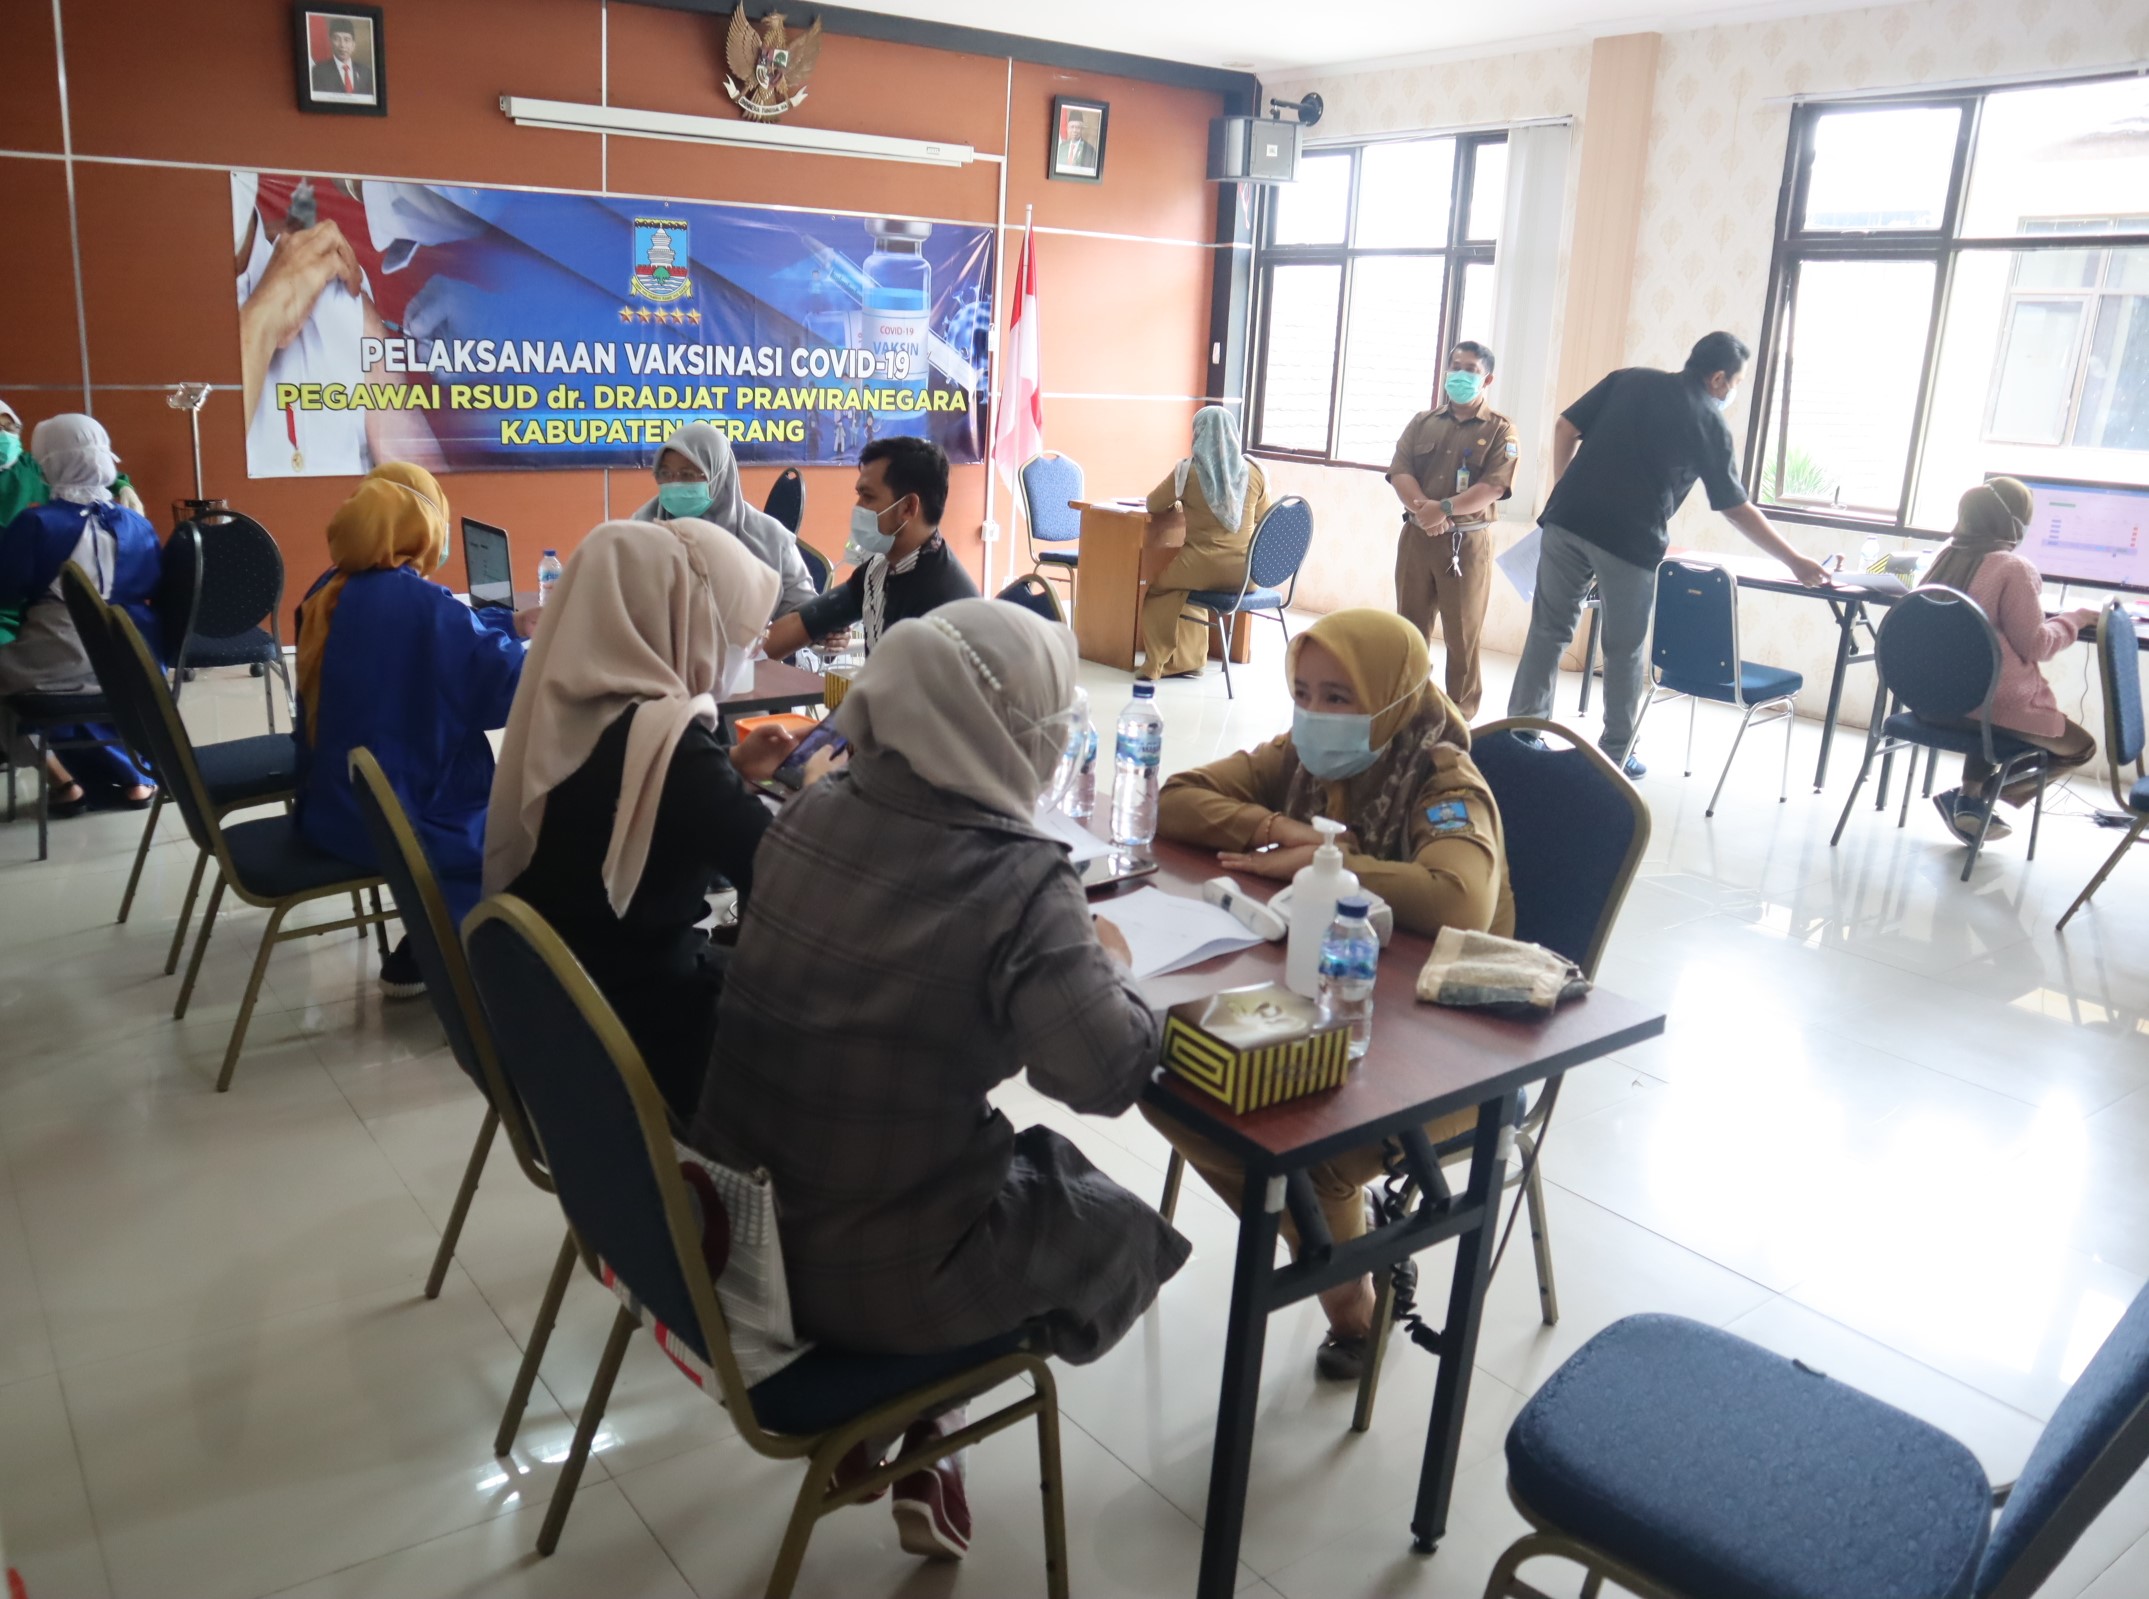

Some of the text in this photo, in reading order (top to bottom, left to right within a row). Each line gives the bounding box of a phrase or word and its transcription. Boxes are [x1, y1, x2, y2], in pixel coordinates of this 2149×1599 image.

[880, 326, 914, 335] COVID-19
[361, 338, 910, 380] PELAKSANAAN VAKSINASI COVID-19
[873, 341, 919, 356] VAKSIN
[276, 383, 967, 412] PEGAWAI RSUD dr. DRADJAT PRAWIRANEGARA
[500, 418, 805, 445] KABUPATEN RANG
